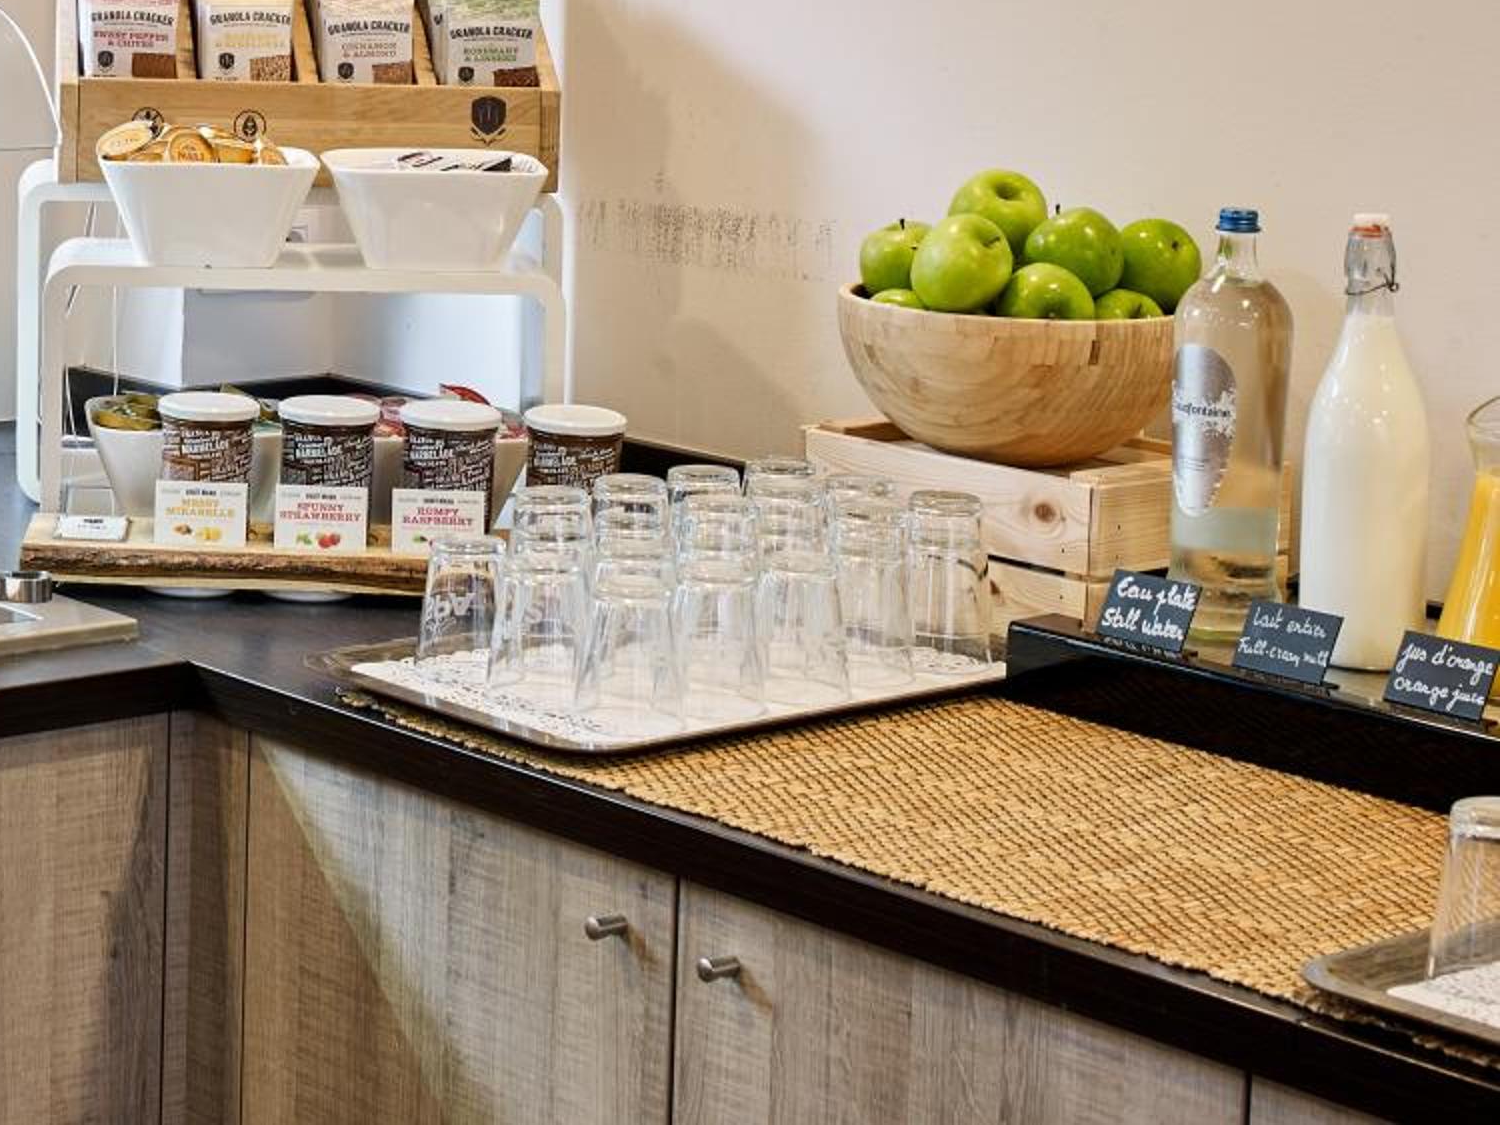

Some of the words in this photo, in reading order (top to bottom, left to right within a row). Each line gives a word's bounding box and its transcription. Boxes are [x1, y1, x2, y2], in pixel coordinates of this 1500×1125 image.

[91, 10, 132, 24] GRANOLA
[133, 10, 175, 26] CRACKER
[209, 11, 250, 26] GRANOLA
[327, 20, 369, 35] GRANOLA
[371, 20, 410, 33] CRACKER
[450, 26, 491, 39] GRANOLA
[493, 26, 533, 39] CRACKER
[1141, 615, 1184, 641] water
